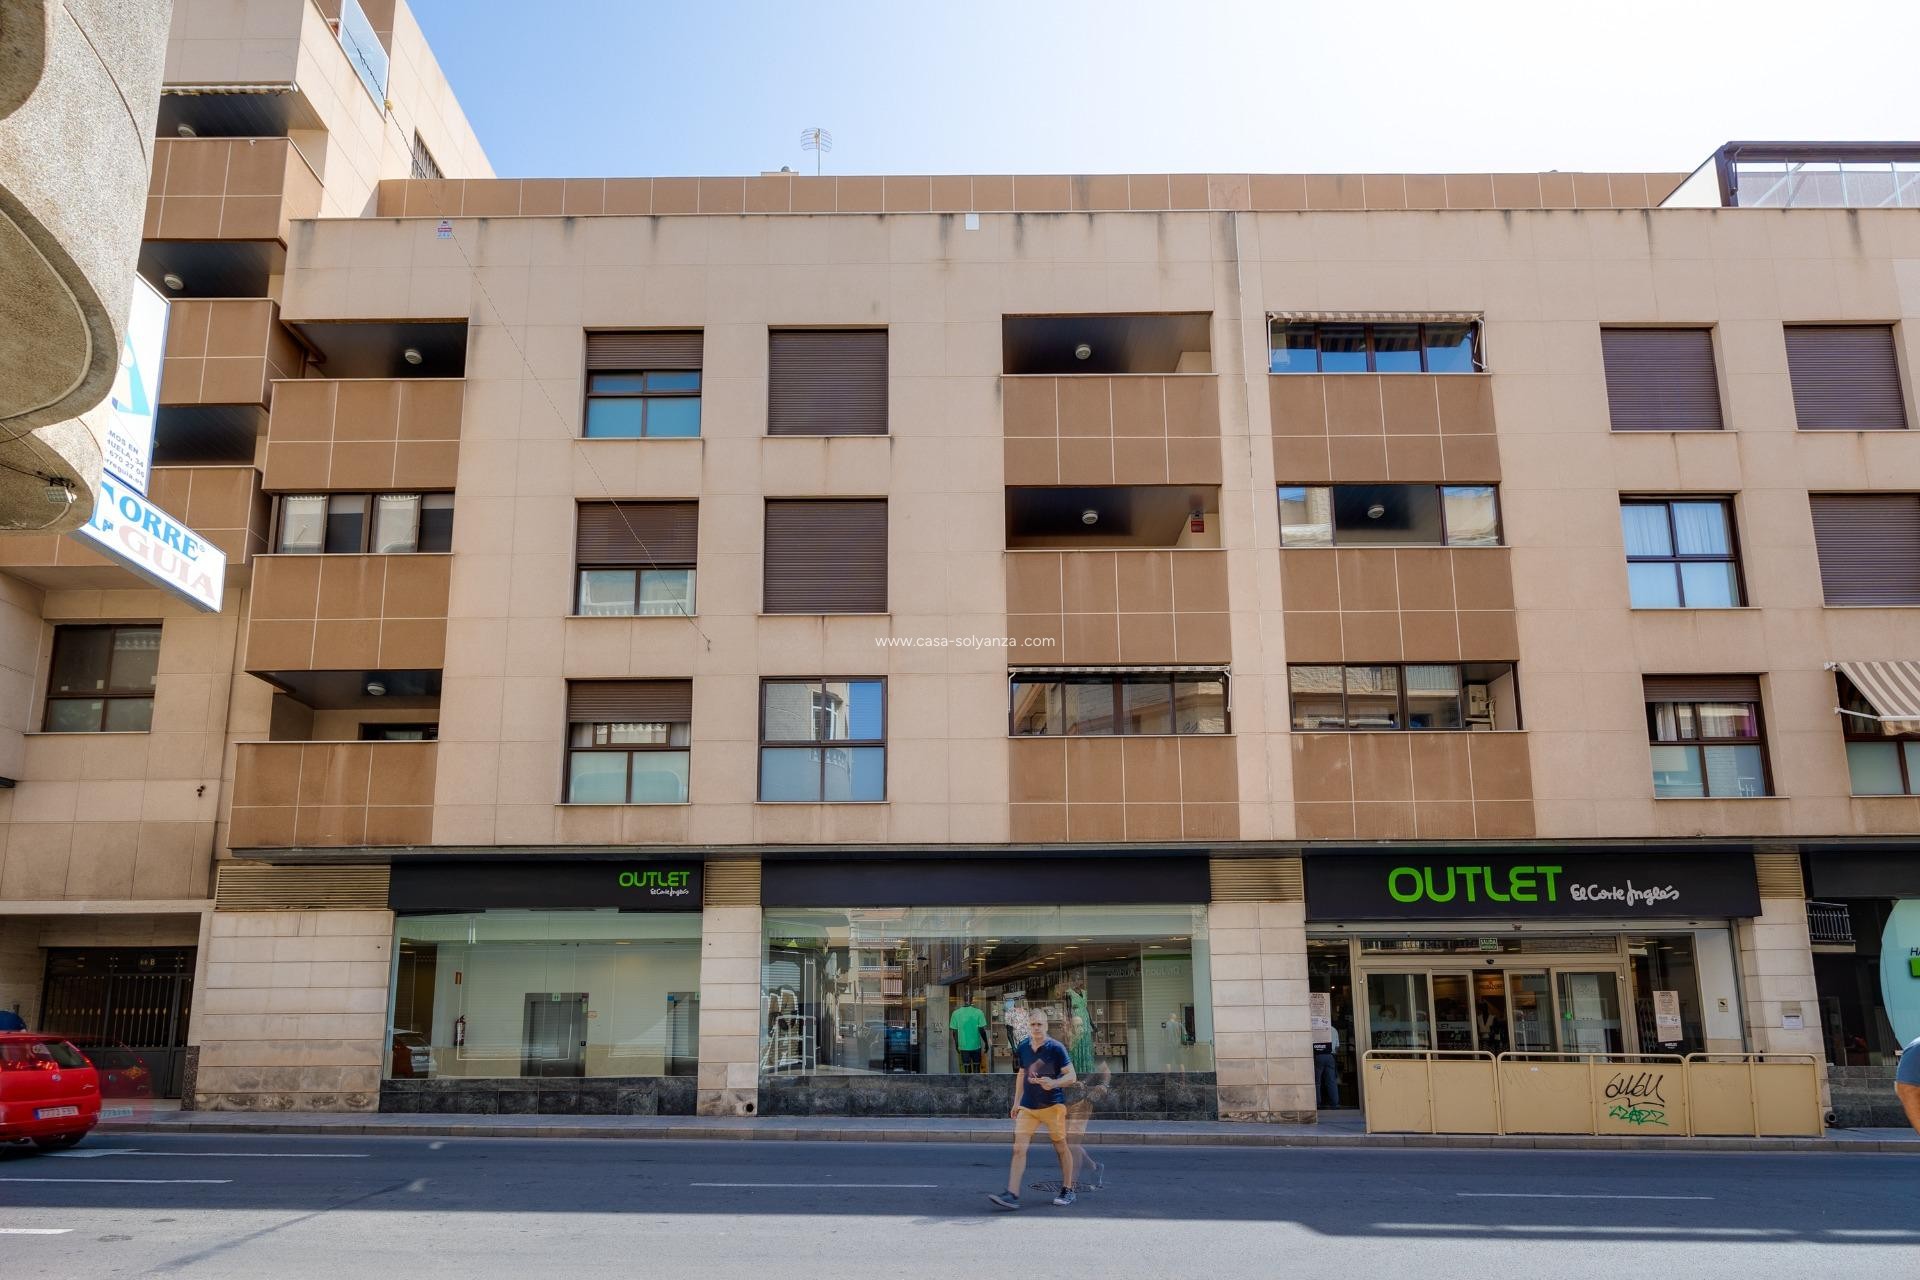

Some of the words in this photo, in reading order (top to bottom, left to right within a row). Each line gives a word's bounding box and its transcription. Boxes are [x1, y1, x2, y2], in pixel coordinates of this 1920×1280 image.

[119, 525, 216, 600] GUIA
[619, 871, 690, 887] OUTLET
[1388, 866, 1562, 903] OUTLET
[1569, 883, 1588, 901] El
[1588, 884, 1625, 901] Corte
[1626, 879, 1680, 907] Inglés
